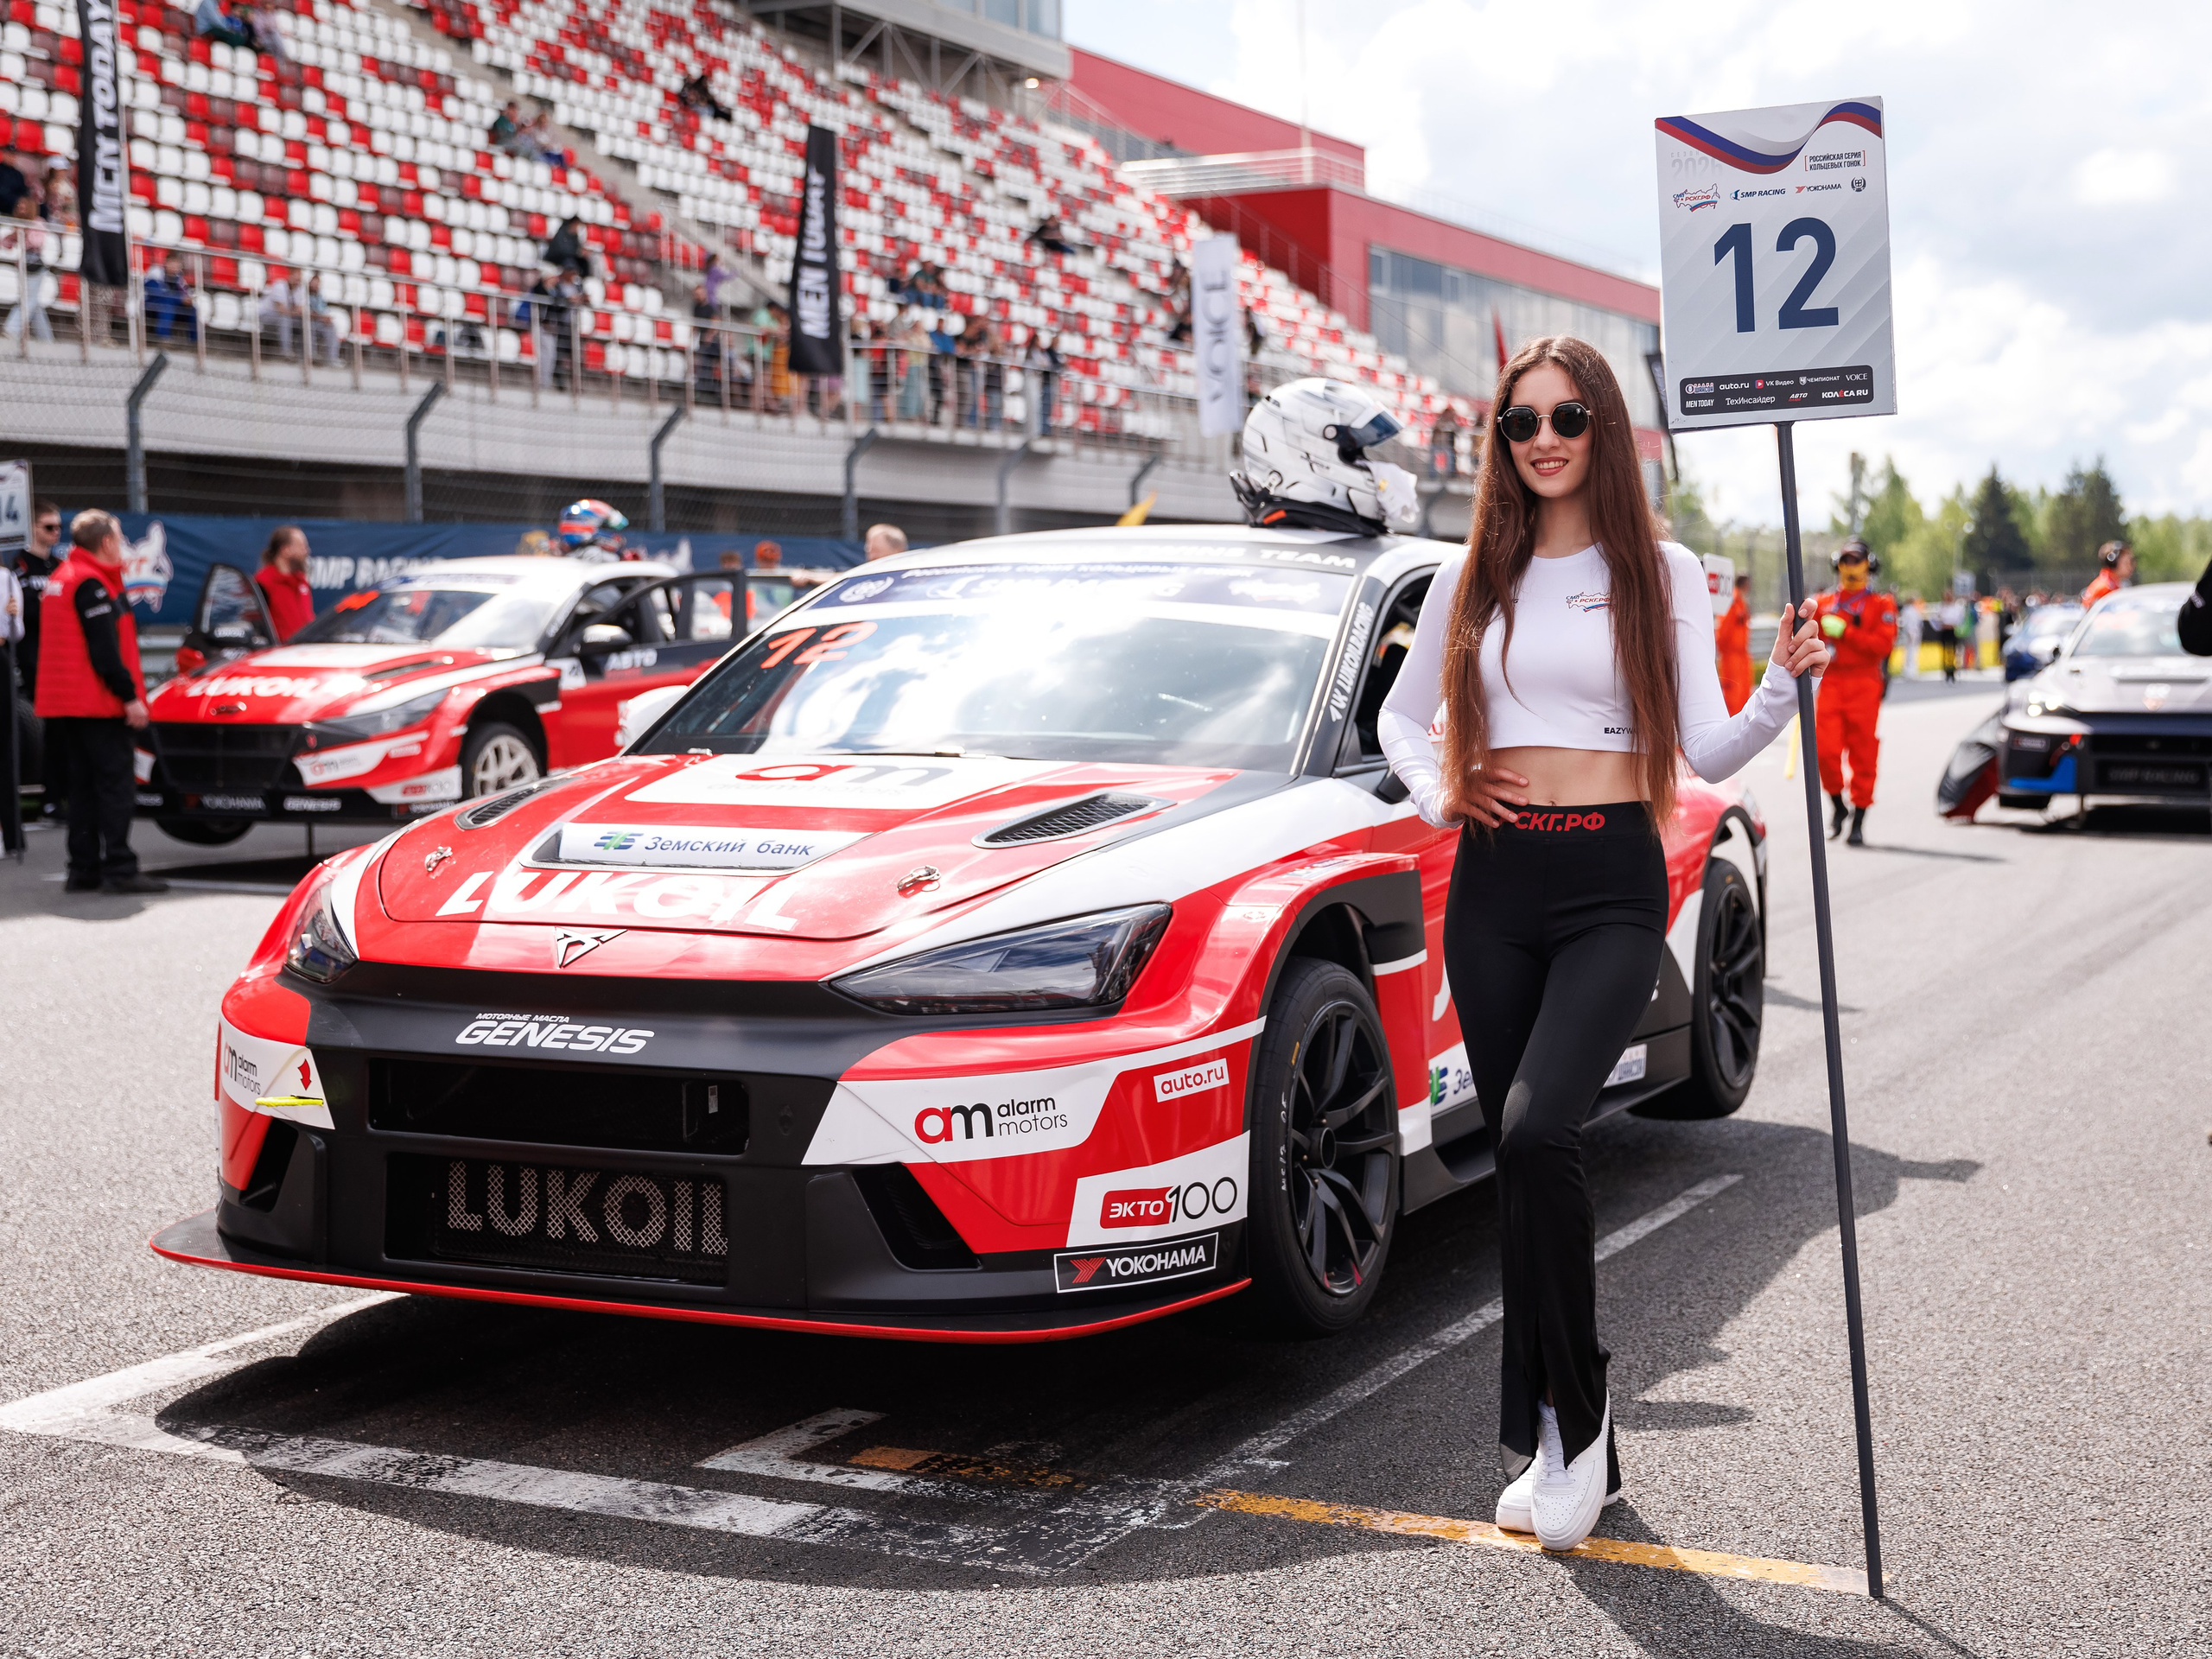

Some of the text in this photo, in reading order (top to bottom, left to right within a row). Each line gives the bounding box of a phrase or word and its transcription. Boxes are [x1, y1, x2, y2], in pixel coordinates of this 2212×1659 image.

[87, 0, 124, 234] MEN TODAY
[1808, 151, 1861, 162] РОССИЙСКАЯ СЕРИЯ
[1809, 160, 1861, 171] КОЛЬЦЕВЫХ ГОНОК
[1758, 188, 1786, 197] RACING
[1806, 183, 1842, 192] YOKOHAMA
[1713, 216, 1839, 334] 12
[797, 264, 830, 340] MEN
[1719, 382, 1750, 391] auto.ru
[1846, 372, 1868, 381] VOICE
[1726, 396, 1776, 406] ТехИнсайдер
[1260, 549, 1356, 569] TEAM
[760, 621, 879, 669] 12
[1500, 811, 1605, 831] СКГ.РФ
[645, 835, 816, 856] Земский банк
[435, 870, 804, 931] LUKOIL
[476, 1013, 570, 1023] МОТОРНЫЕ МАСЛА
[455, 1020, 655, 1054] GENESIS
[1160, 1065, 1224, 1095] auto.ru
[996, 1096, 1056, 1117] alarm
[914, 1102, 995, 1144] am
[998, 1111, 1068, 1136] motors
[447, 1160, 728, 1255] LUKOIL
[1105, 1244, 1206, 1277] YOKOHAMA
